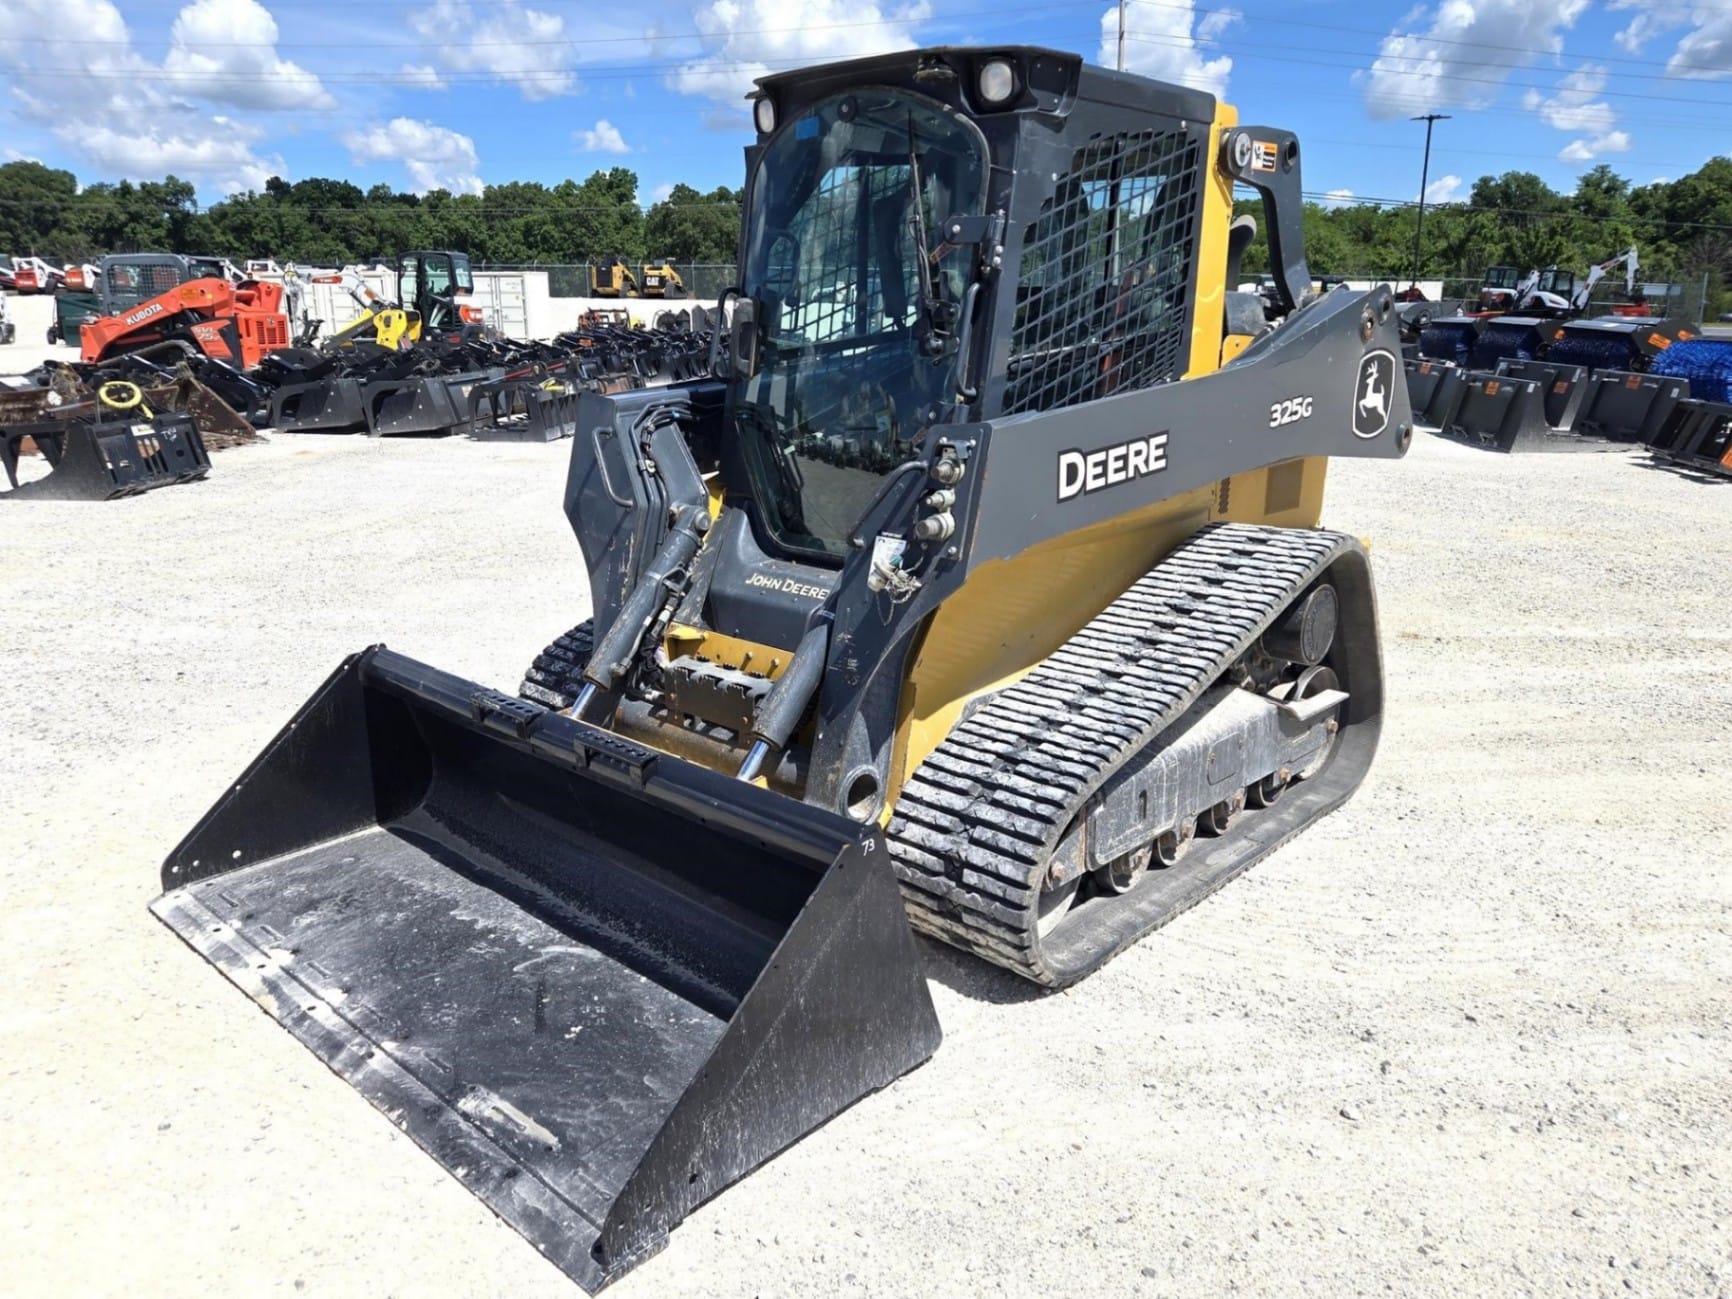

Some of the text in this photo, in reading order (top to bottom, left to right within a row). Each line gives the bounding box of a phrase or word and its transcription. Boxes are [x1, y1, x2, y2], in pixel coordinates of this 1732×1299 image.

[126, 303, 163, 325] KUBOTA
[1269, 396, 1313, 428] 325G
[1058, 432, 1169, 501] DEERE
[745, 573, 831, 600] JOHN DEERE
[861, 838, 875, 856] 73
